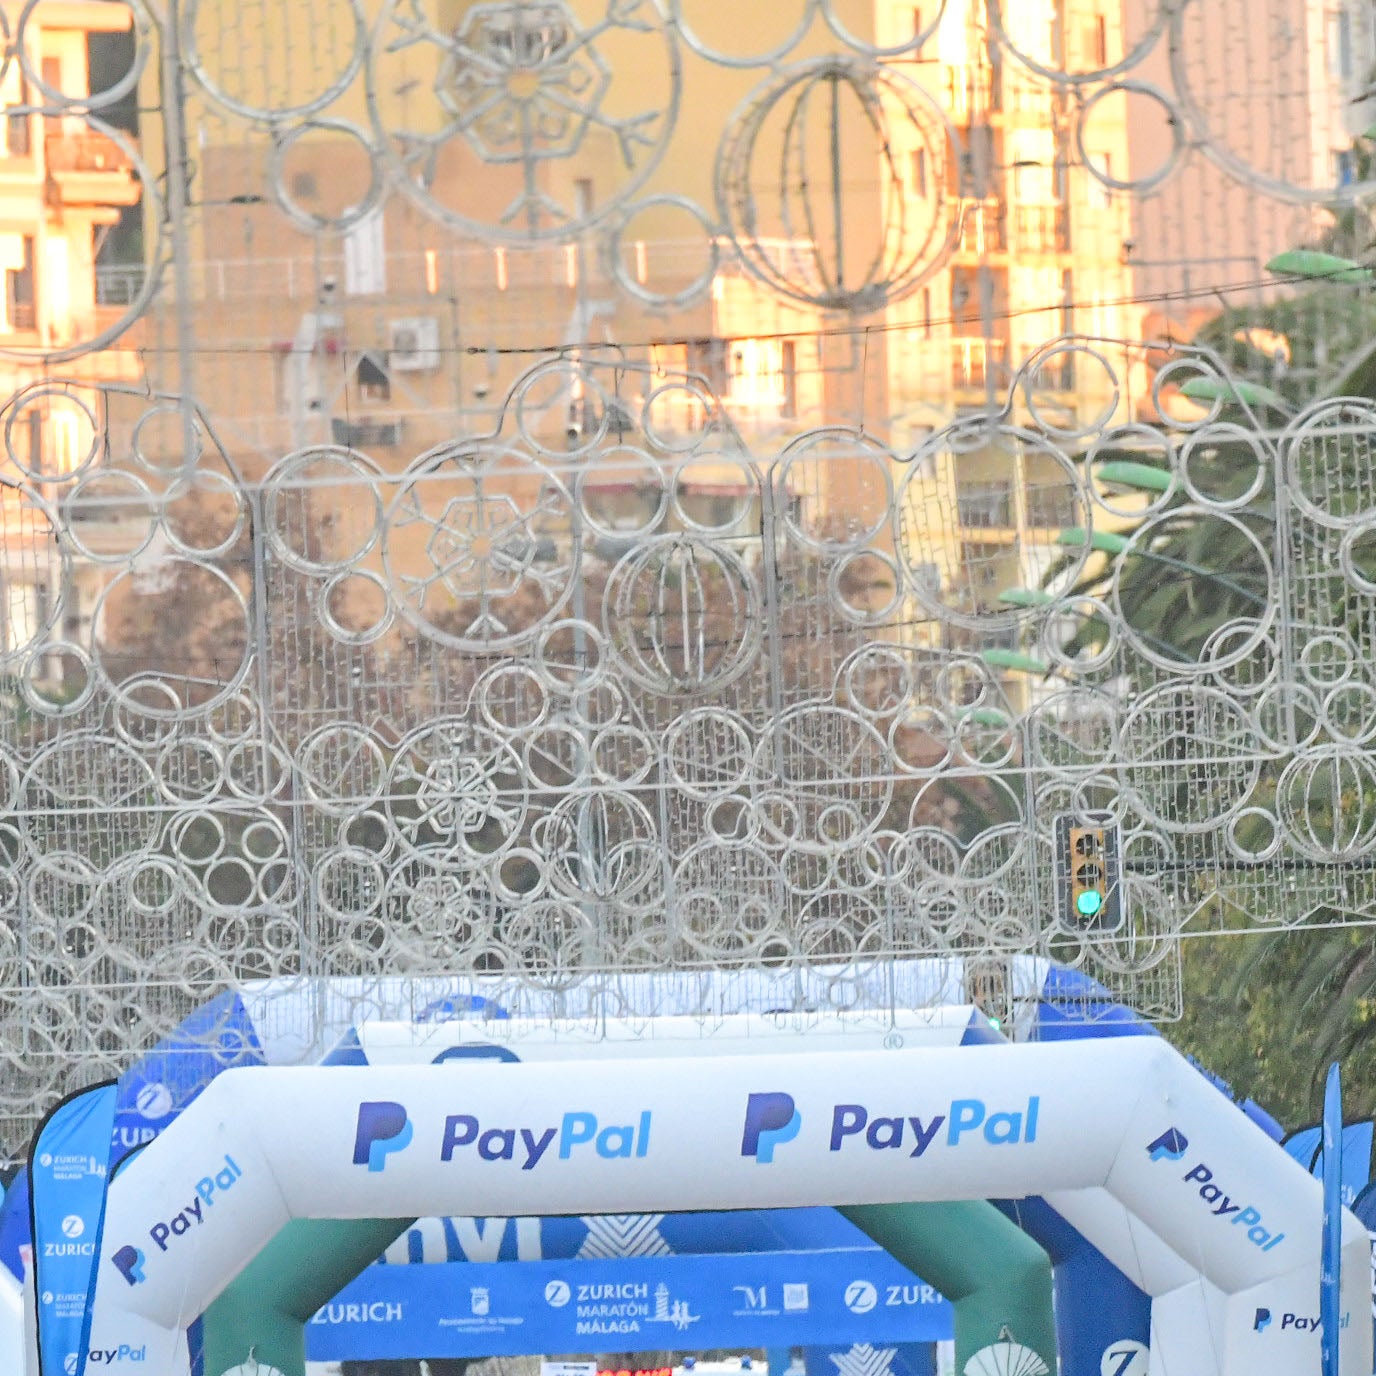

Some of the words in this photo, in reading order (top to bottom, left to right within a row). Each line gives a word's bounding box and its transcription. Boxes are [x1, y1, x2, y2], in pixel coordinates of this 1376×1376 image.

[829, 1096, 1040, 1158] PayPal
[440, 1110, 652, 1171] PayPal
[150, 1154, 242, 1252] PayPal
[1182, 1162, 1286, 1253] PayPal
[577, 1283, 648, 1301] ZURICH
[311, 1302, 403, 1325] ZURICH
[577, 1302, 649, 1318] MARATÓN
[576, 1319, 640, 1335] MÁLAGA
[88, 1344, 146, 1364] ayPal
